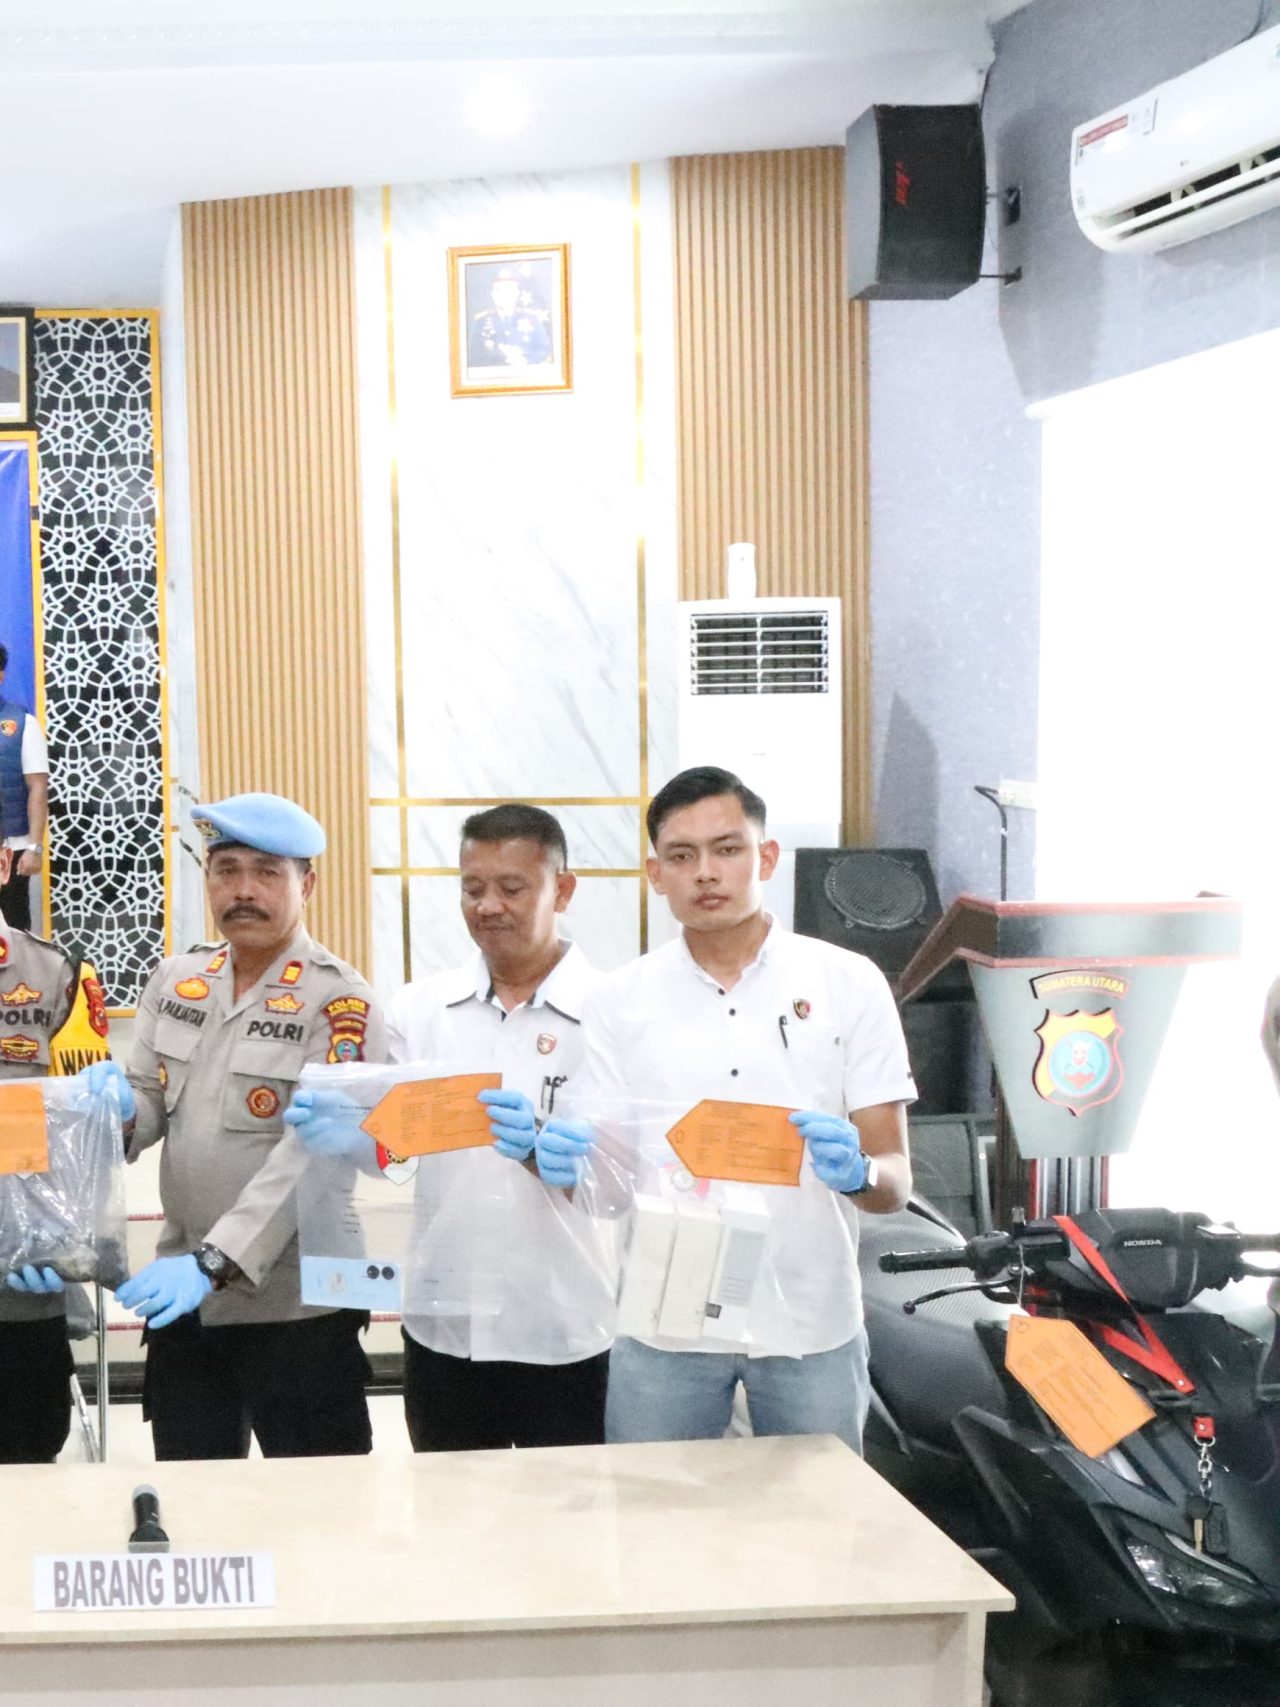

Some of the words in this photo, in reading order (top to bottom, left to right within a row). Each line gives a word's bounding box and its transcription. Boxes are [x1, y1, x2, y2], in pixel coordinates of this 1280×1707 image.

[1037, 976, 1091, 994] SUMATERA
[1092, 976, 1125, 993] UTARA
[246, 1020, 305, 1042] POLRI
[1123, 1239, 1162, 1247] HONDA
[53, 1558, 164, 1608] BARANG
[173, 1556, 255, 1604] BUKTI
